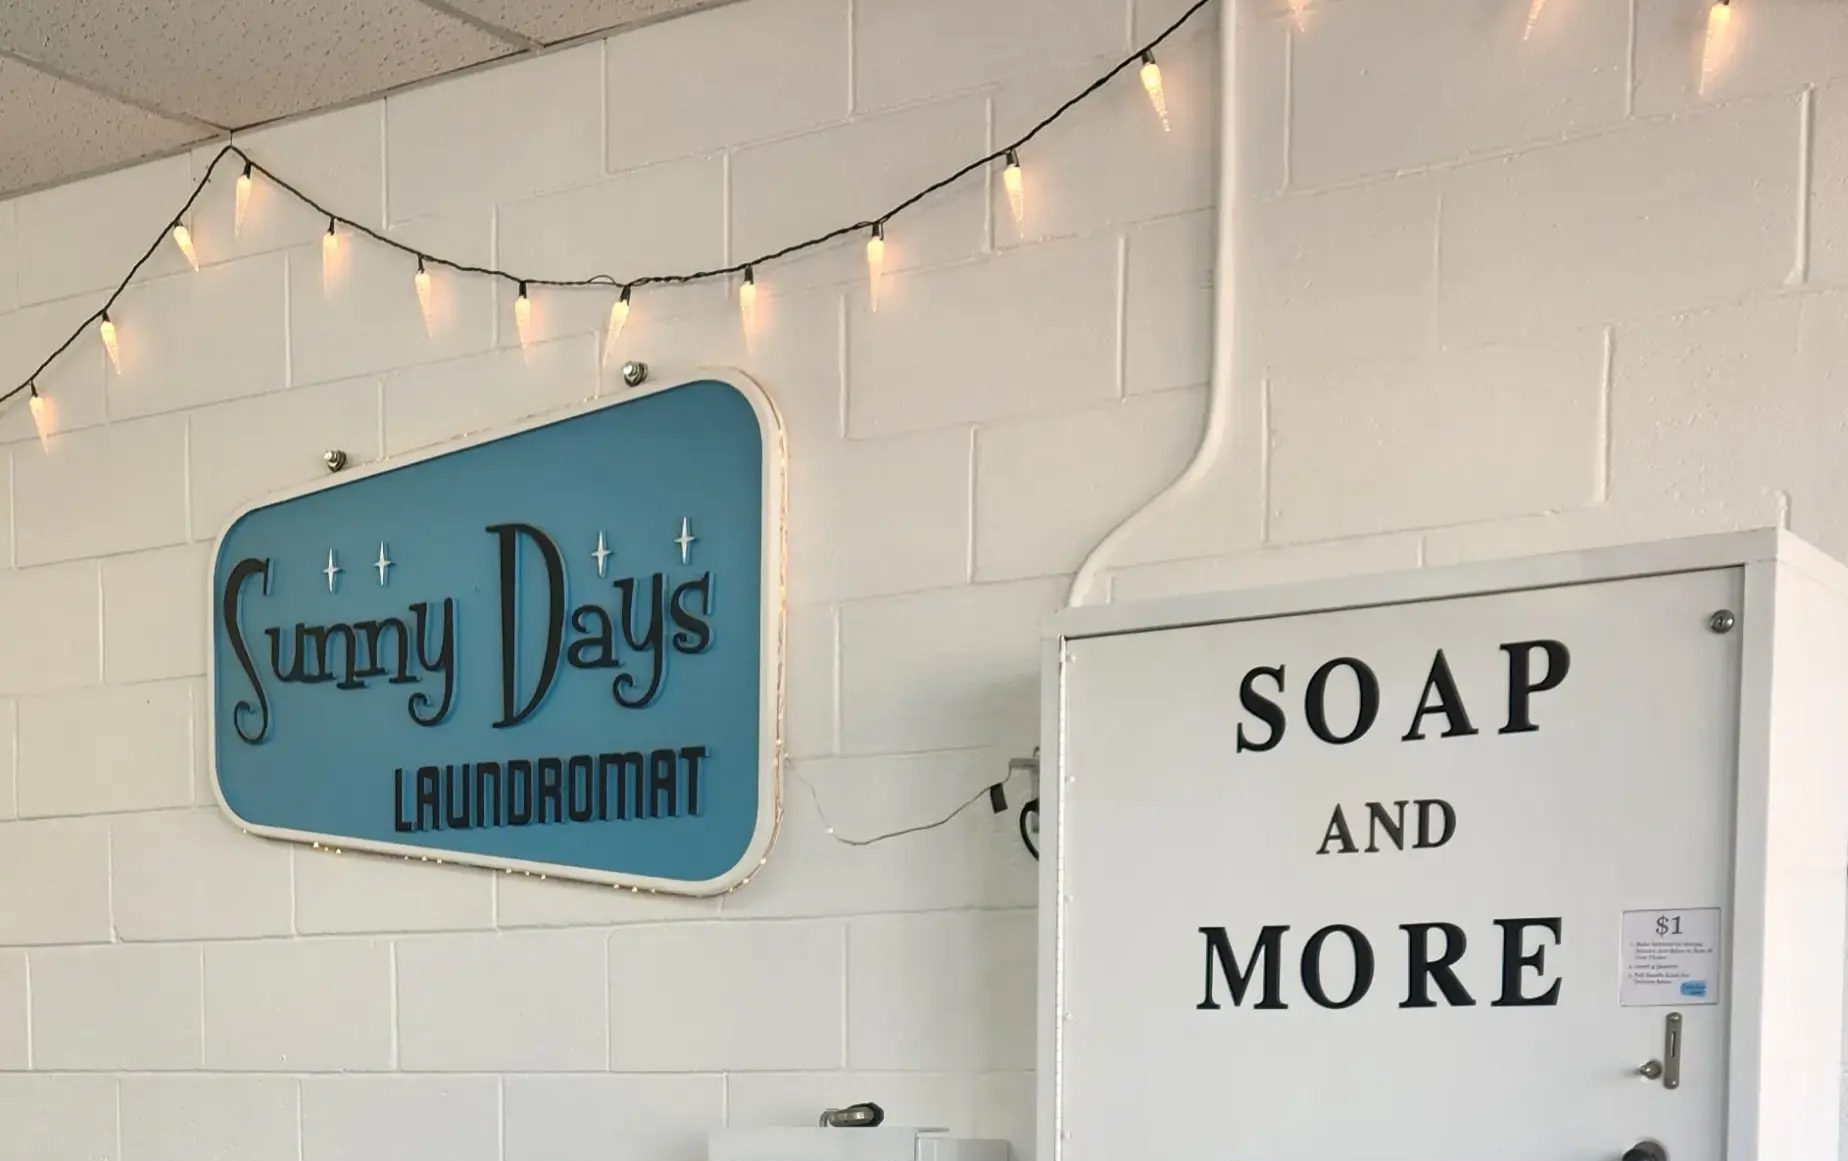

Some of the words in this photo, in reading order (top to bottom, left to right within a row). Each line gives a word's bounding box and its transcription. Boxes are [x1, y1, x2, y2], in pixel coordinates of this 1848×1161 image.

[223, 557, 455, 745] Sunny
[485, 522, 712, 729] Days
[1236, 639, 1571, 754] SOAP
[394, 746, 708, 833] LAUNDROMAT
[1315, 798, 1457, 855] AND
[1196, 916, 1563, 1010] MORE
[1655, 914, 1683, 938] $1
